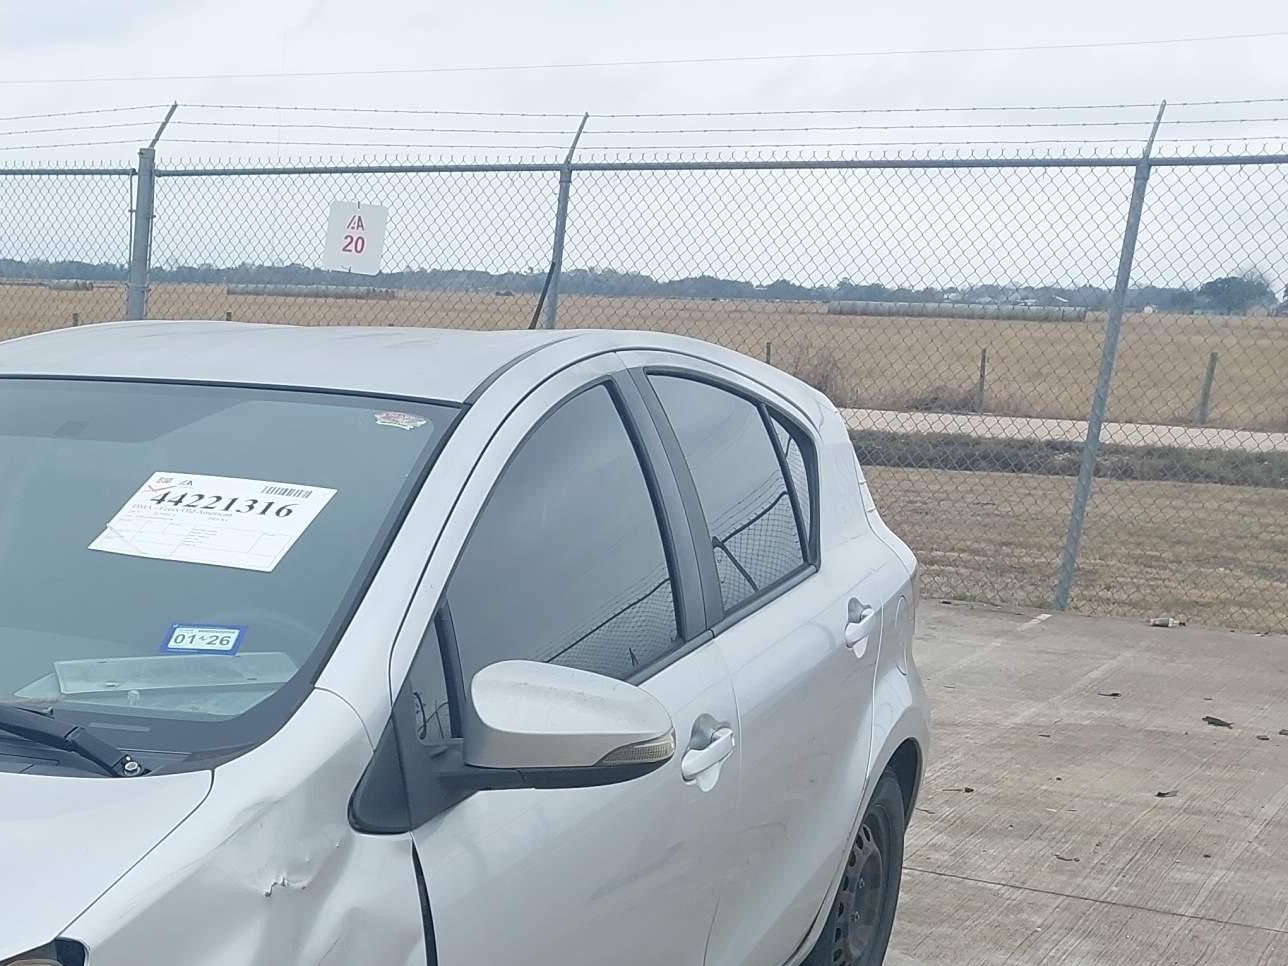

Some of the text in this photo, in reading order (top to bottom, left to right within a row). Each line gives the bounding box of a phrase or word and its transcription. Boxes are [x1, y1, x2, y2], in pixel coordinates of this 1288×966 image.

[342, 234, 365, 254] 20
[150, 490, 300, 519] 44221316
[174, 633, 232, 646] 01 26
